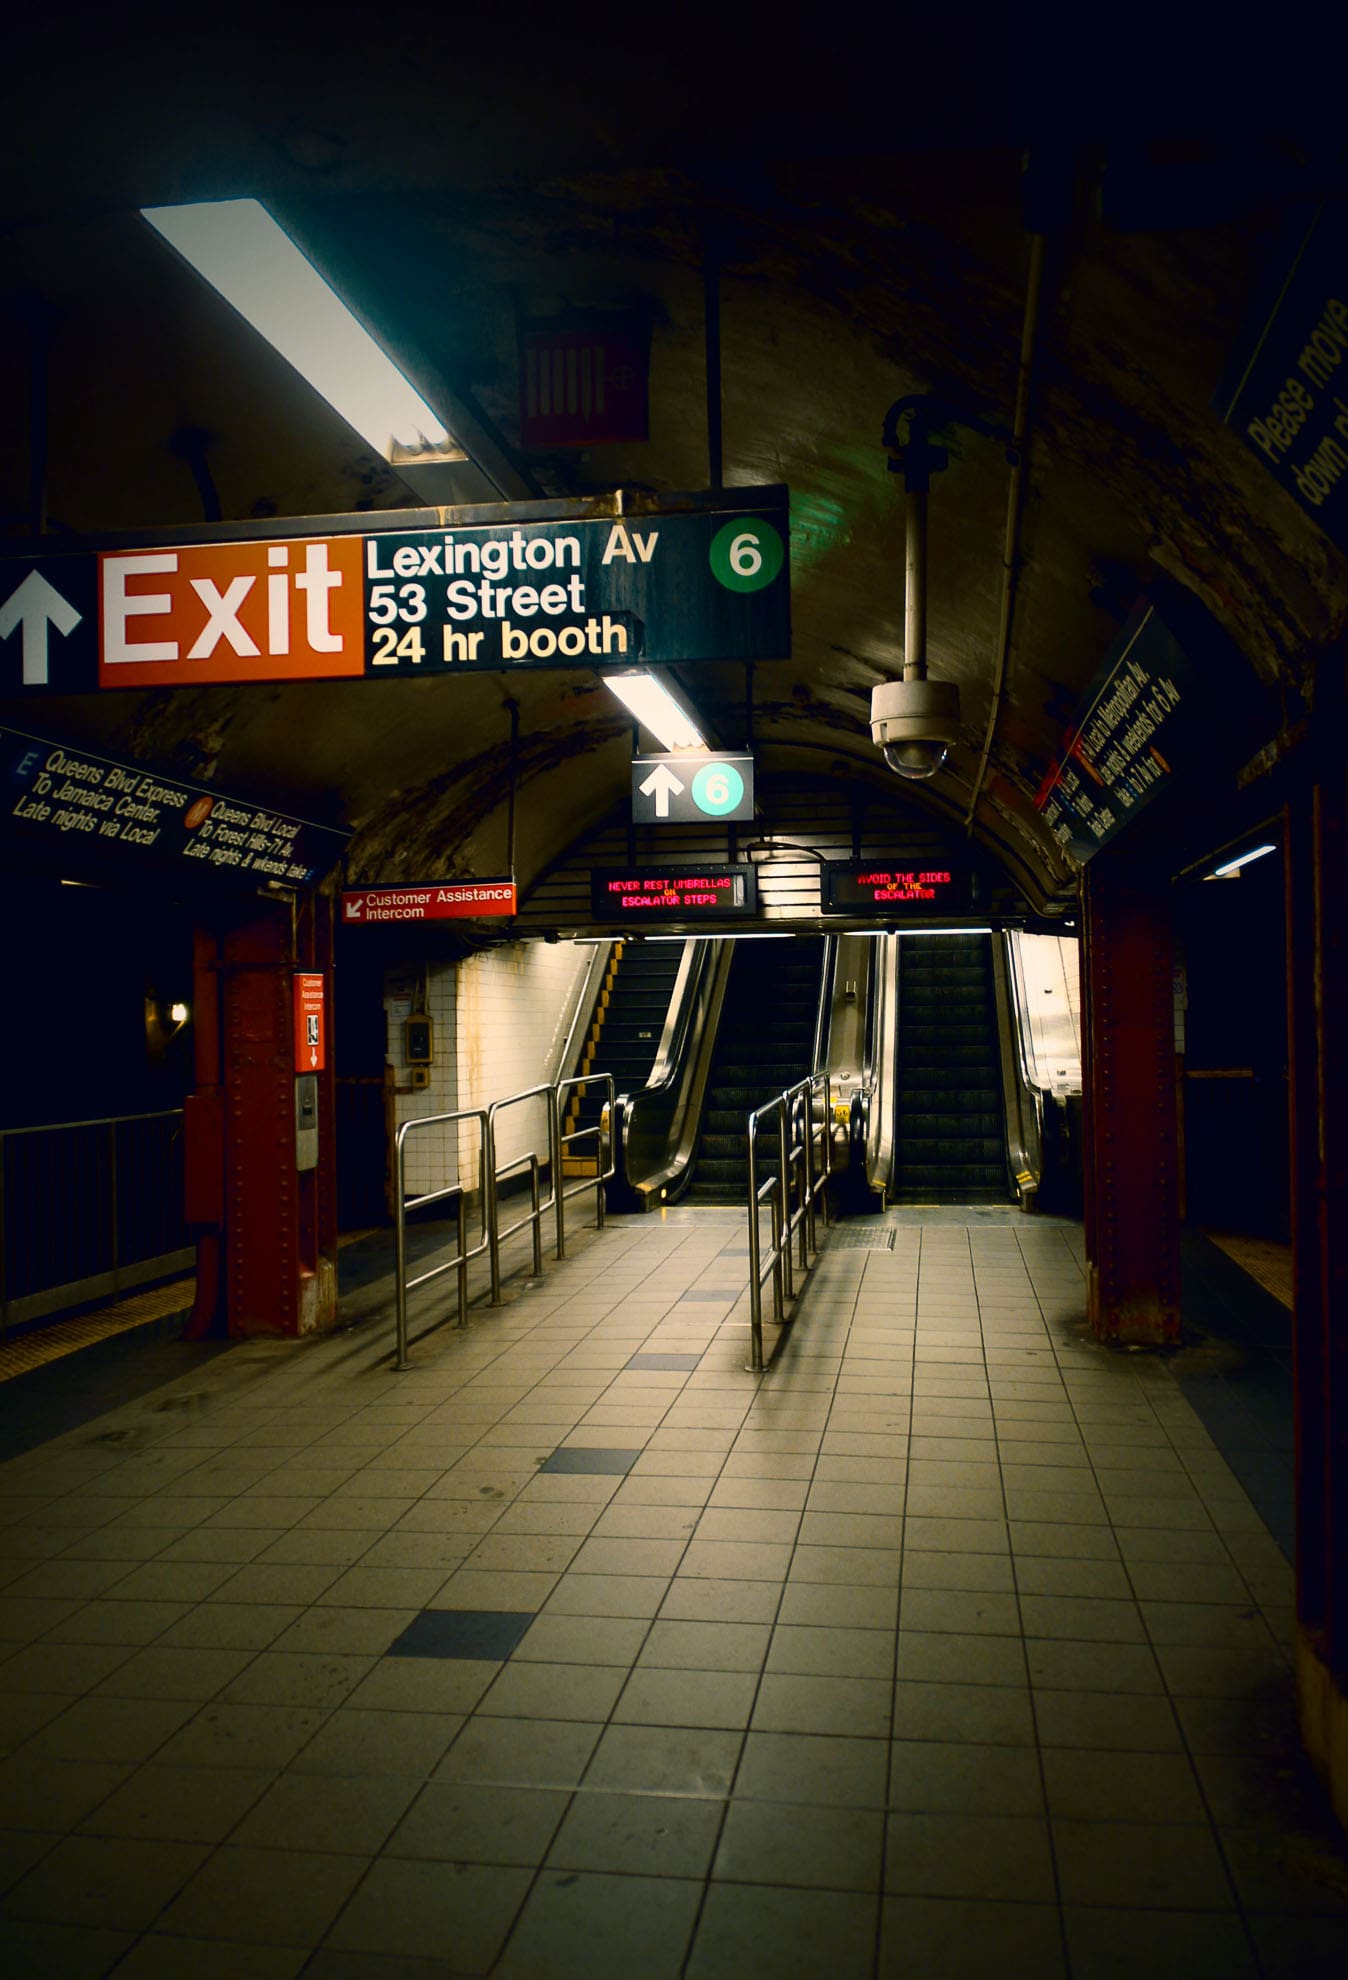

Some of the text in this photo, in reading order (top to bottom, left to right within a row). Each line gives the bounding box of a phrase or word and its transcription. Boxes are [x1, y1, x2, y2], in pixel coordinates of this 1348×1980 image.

[1249, 297, 1348, 465] Please move
[1289, 434, 1348, 506] down
[367, 525, 660, 581] Lexington Av
[729, 534, 762, 576] 6
[103, 544, 343, 664] Exit
[367, 574, 586, 625] 53 Street
[371, 616, 628, 666] 24 hr booth
[1152, 685, 1171, 712] 6
[1158, 676, 1181, 706] Av
[16, 752, 39, 776] E
[45, 750, 188, 808] Queens Blvd Express
[31, 771, 161, 824] To Jamaica Center.
[706, 774, 729, 805] 6
[11, 794, 161, 846] Late nights via Local
[198, 819, 214, 838] To
[211, 823, 249, 846] Forest
[210, 801, 302, 839] Queens Blvd Local
[182, 838, 211, 859] Late
[208, 845, 242, 867] nights
[608, 878, 731, 892] NEVER REST UMBRELLAS
[895, 873, 914, 883] THE
[919, 872, 951, 882] SIDES
[366, 888, 513, 907] Customer Assistance
[366, 907, 425, 920] Intercom
[622, 894, 717, 907] ESCALATOR STEPS
